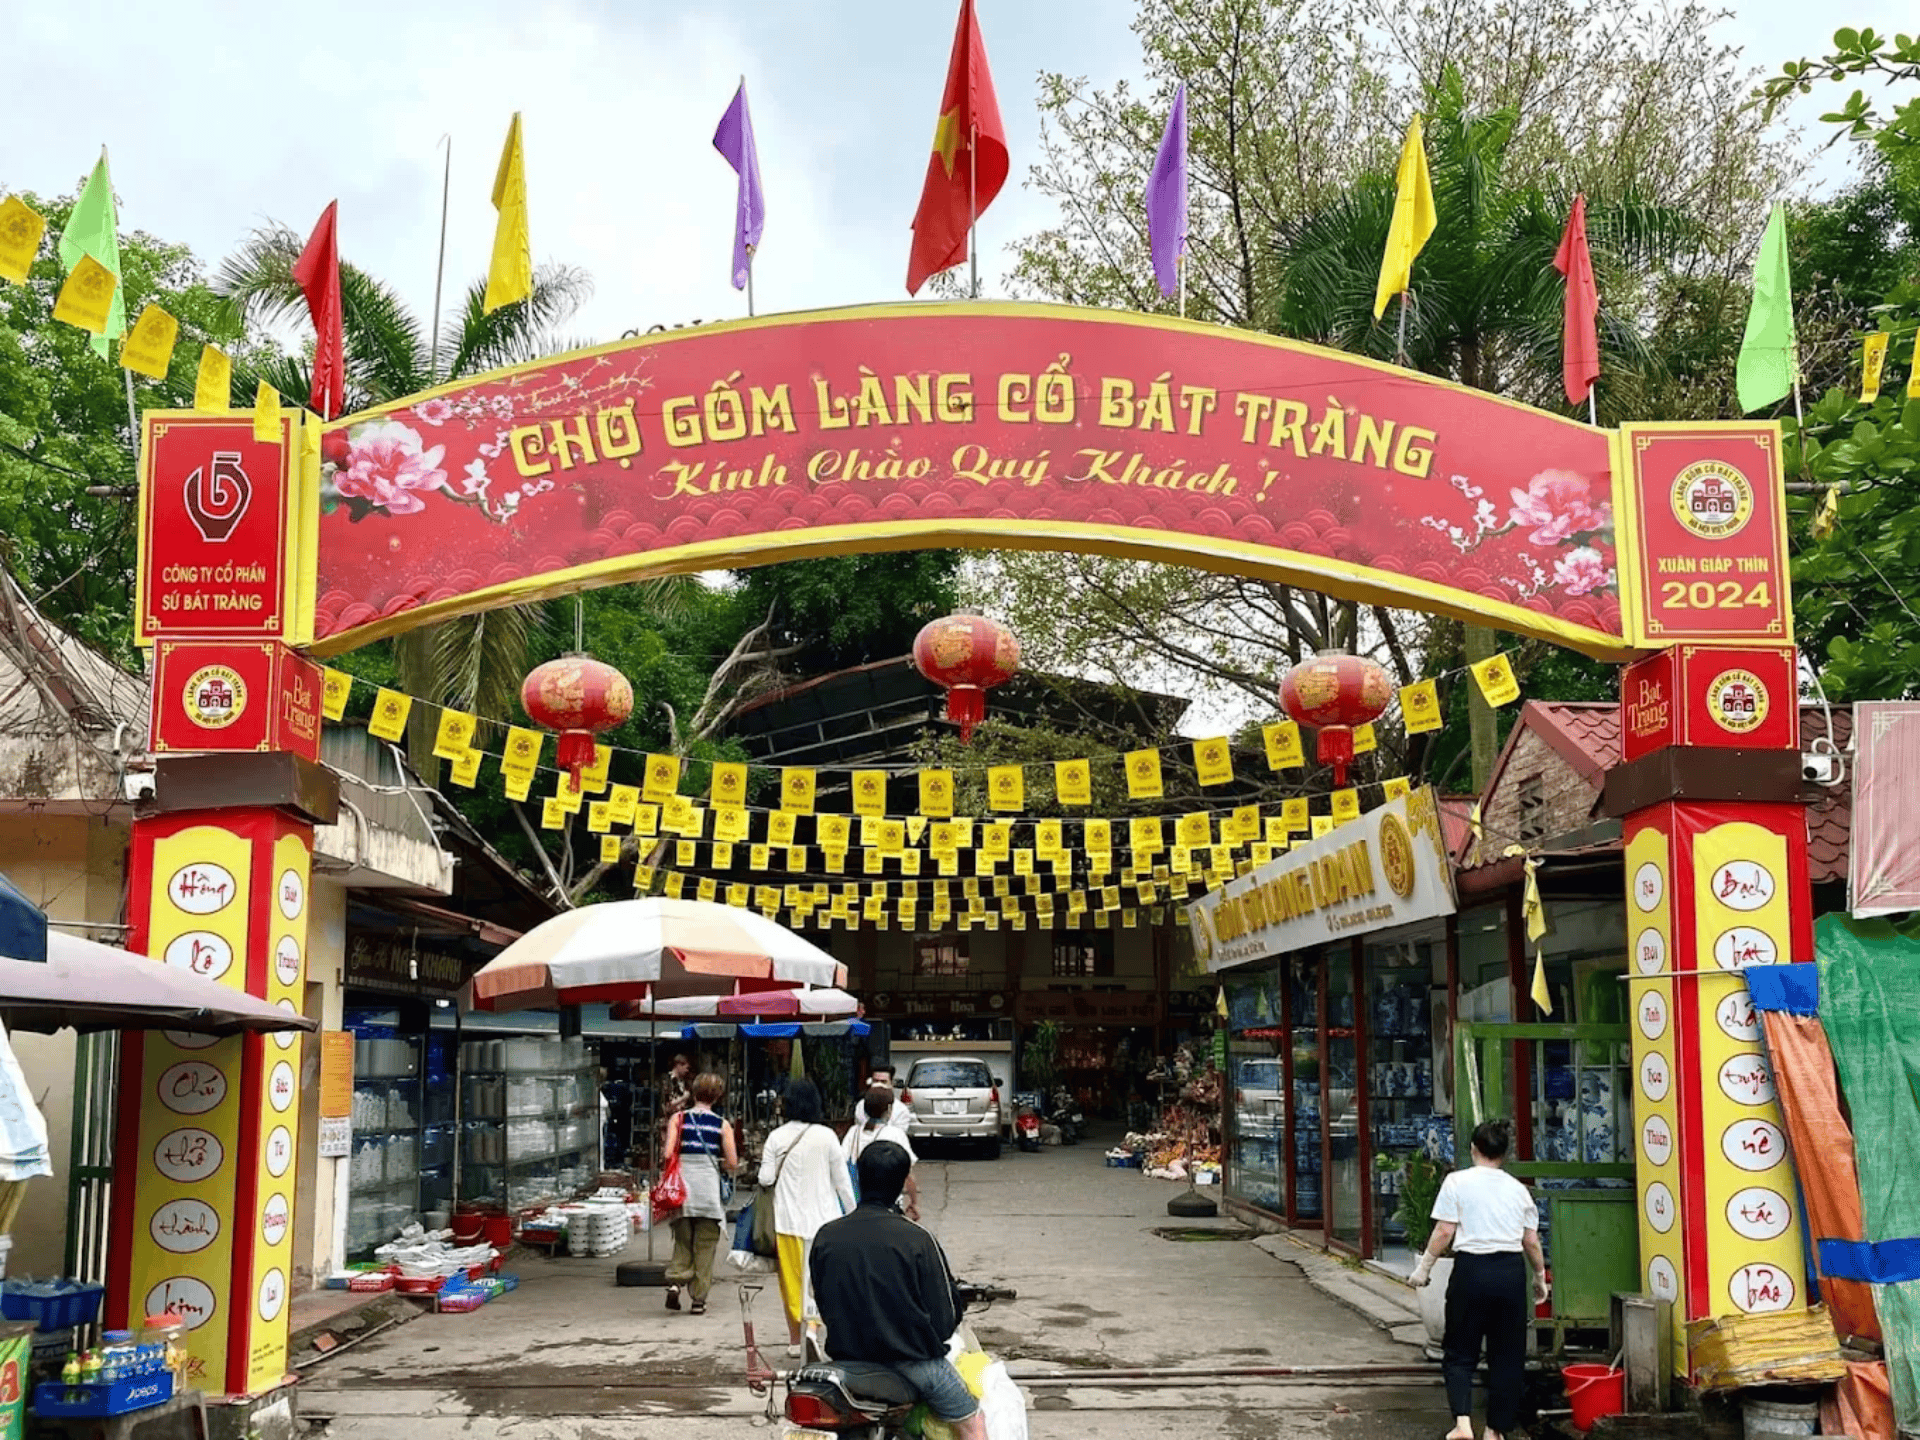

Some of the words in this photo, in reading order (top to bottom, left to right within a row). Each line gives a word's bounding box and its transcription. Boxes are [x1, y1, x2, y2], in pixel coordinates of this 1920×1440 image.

[509, 397, 643, 479] CHỢ
[662, 370, 798, 447] GỐM
[813, 365, 974, 430] LÀNG
[997, 352, 1076, 424] CỔ
[1099, 371, 1218, 436] BÁT
[1235, 395, 1437, 479] TRÀNG
[652, 452, 788, 499] Kính
[807, 448, 935, 487] Chào
[951, 445, 1051, 487] Quý
[1064, 447, 1241, 497] Khách
[162, 563, 198, 583] CÔNG
[200, 566, 213, 583] TY
[215, 559, 234, 583] CỔ
[235, 560, 266, 583] PHẦN
[1658, 555, 1696, 573] XUÂN
[1700, 555, 1733, 573] GIÁP
[1736, 555, 1769, 573] THÌN
[162, 589, 181, 611] SỨ
[183, 589, 210, 611] BÁT
[213, 589, 263, 611] TRÀNG
[1661, 581, 1772, 609] 2024
[1721, 870, 1767, 899] Bạch
[1725, 1000, 1757, 1027] châ
[1740, 1201, 1776, 1224] tác
[164, 1283, 203, 1315] kim
